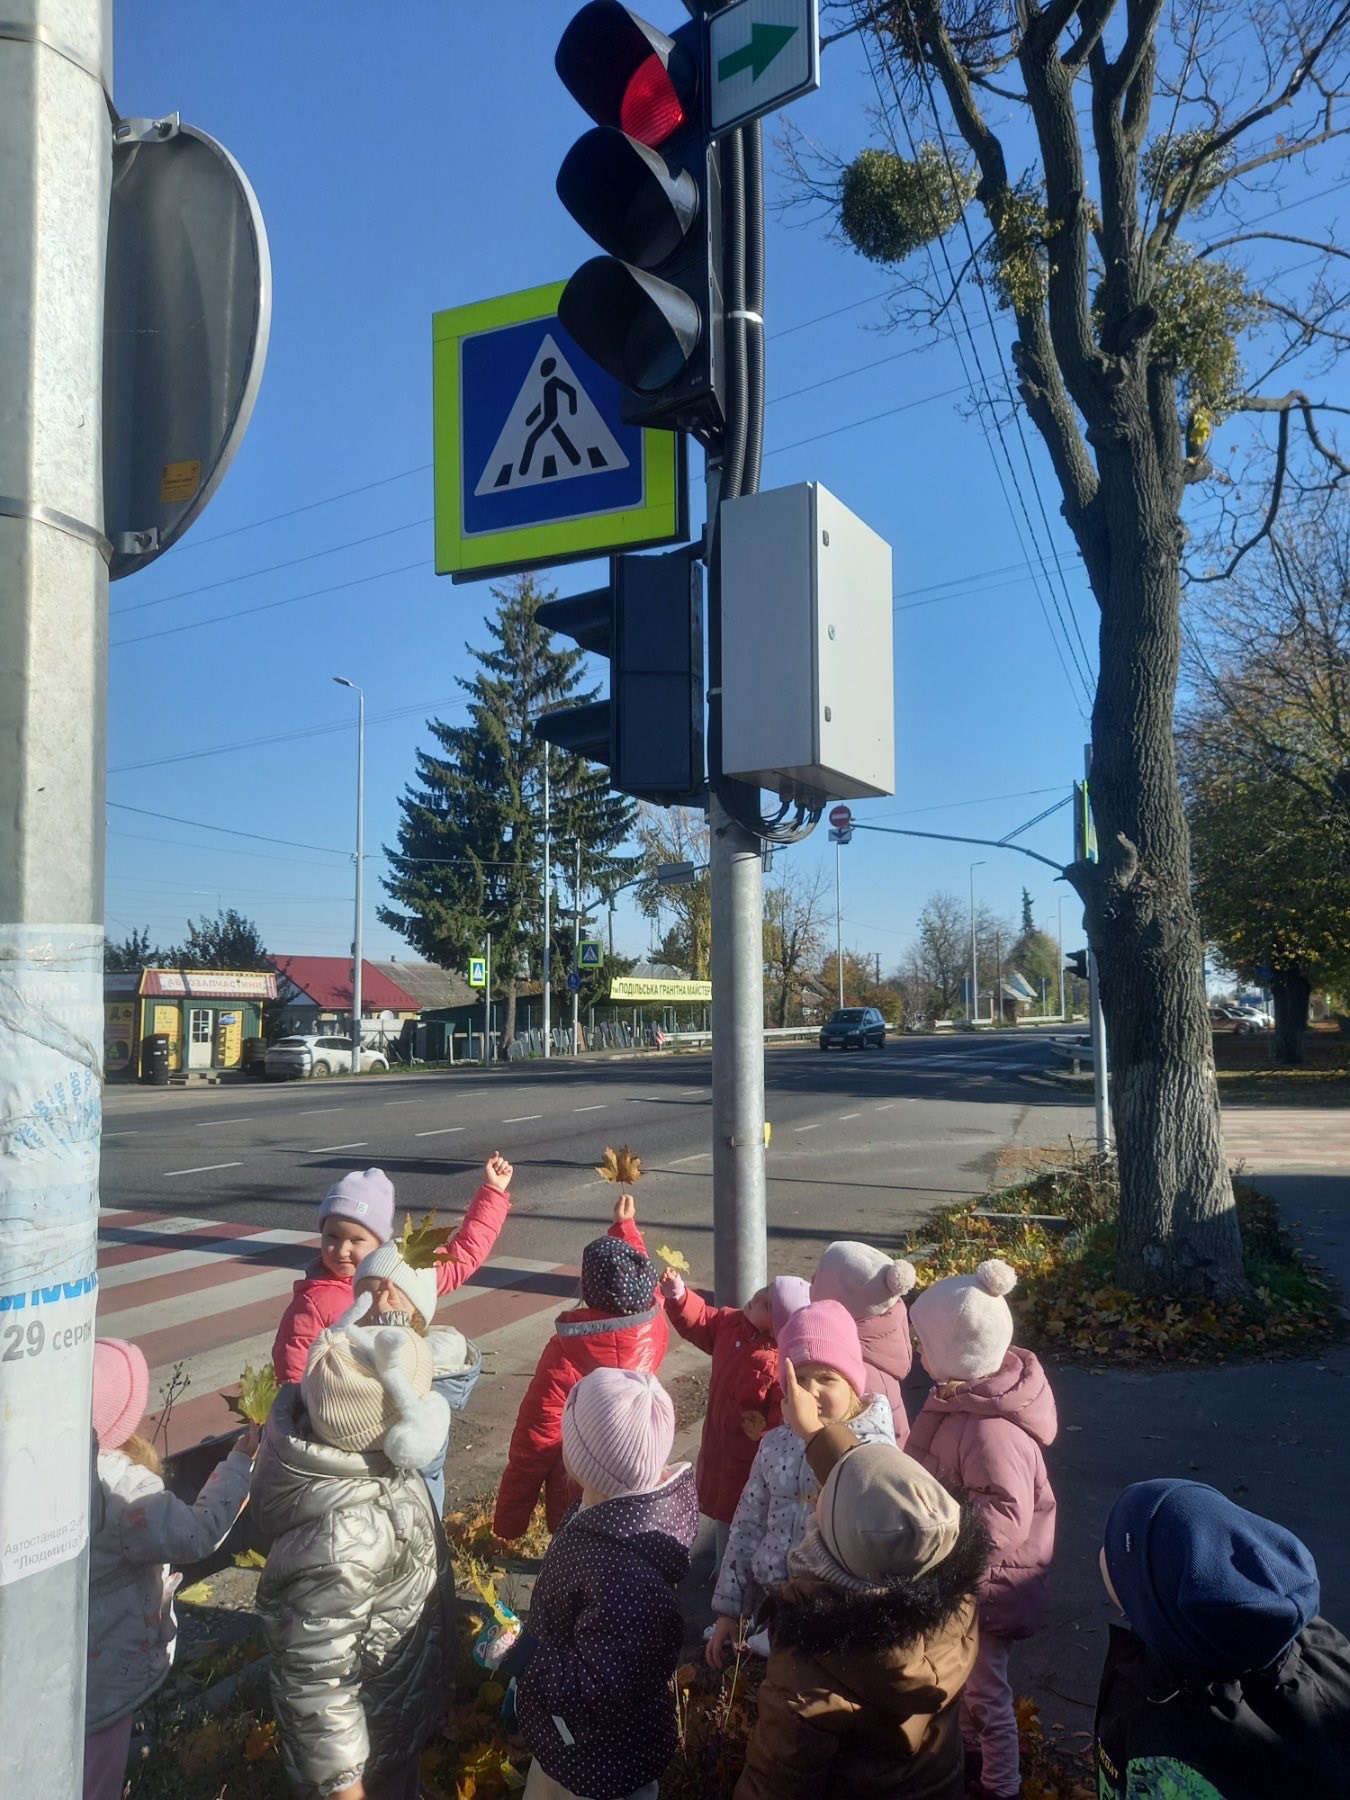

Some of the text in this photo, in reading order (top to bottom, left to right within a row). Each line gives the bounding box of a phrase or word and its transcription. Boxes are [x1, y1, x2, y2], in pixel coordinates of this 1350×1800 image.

[168, 978, 263, 990] АВОЗАПЧАСТИНИ
[619, 983, 658, 996] ПОДІЛЬСЬКА
[2, 1320, 46, 1362] 29
